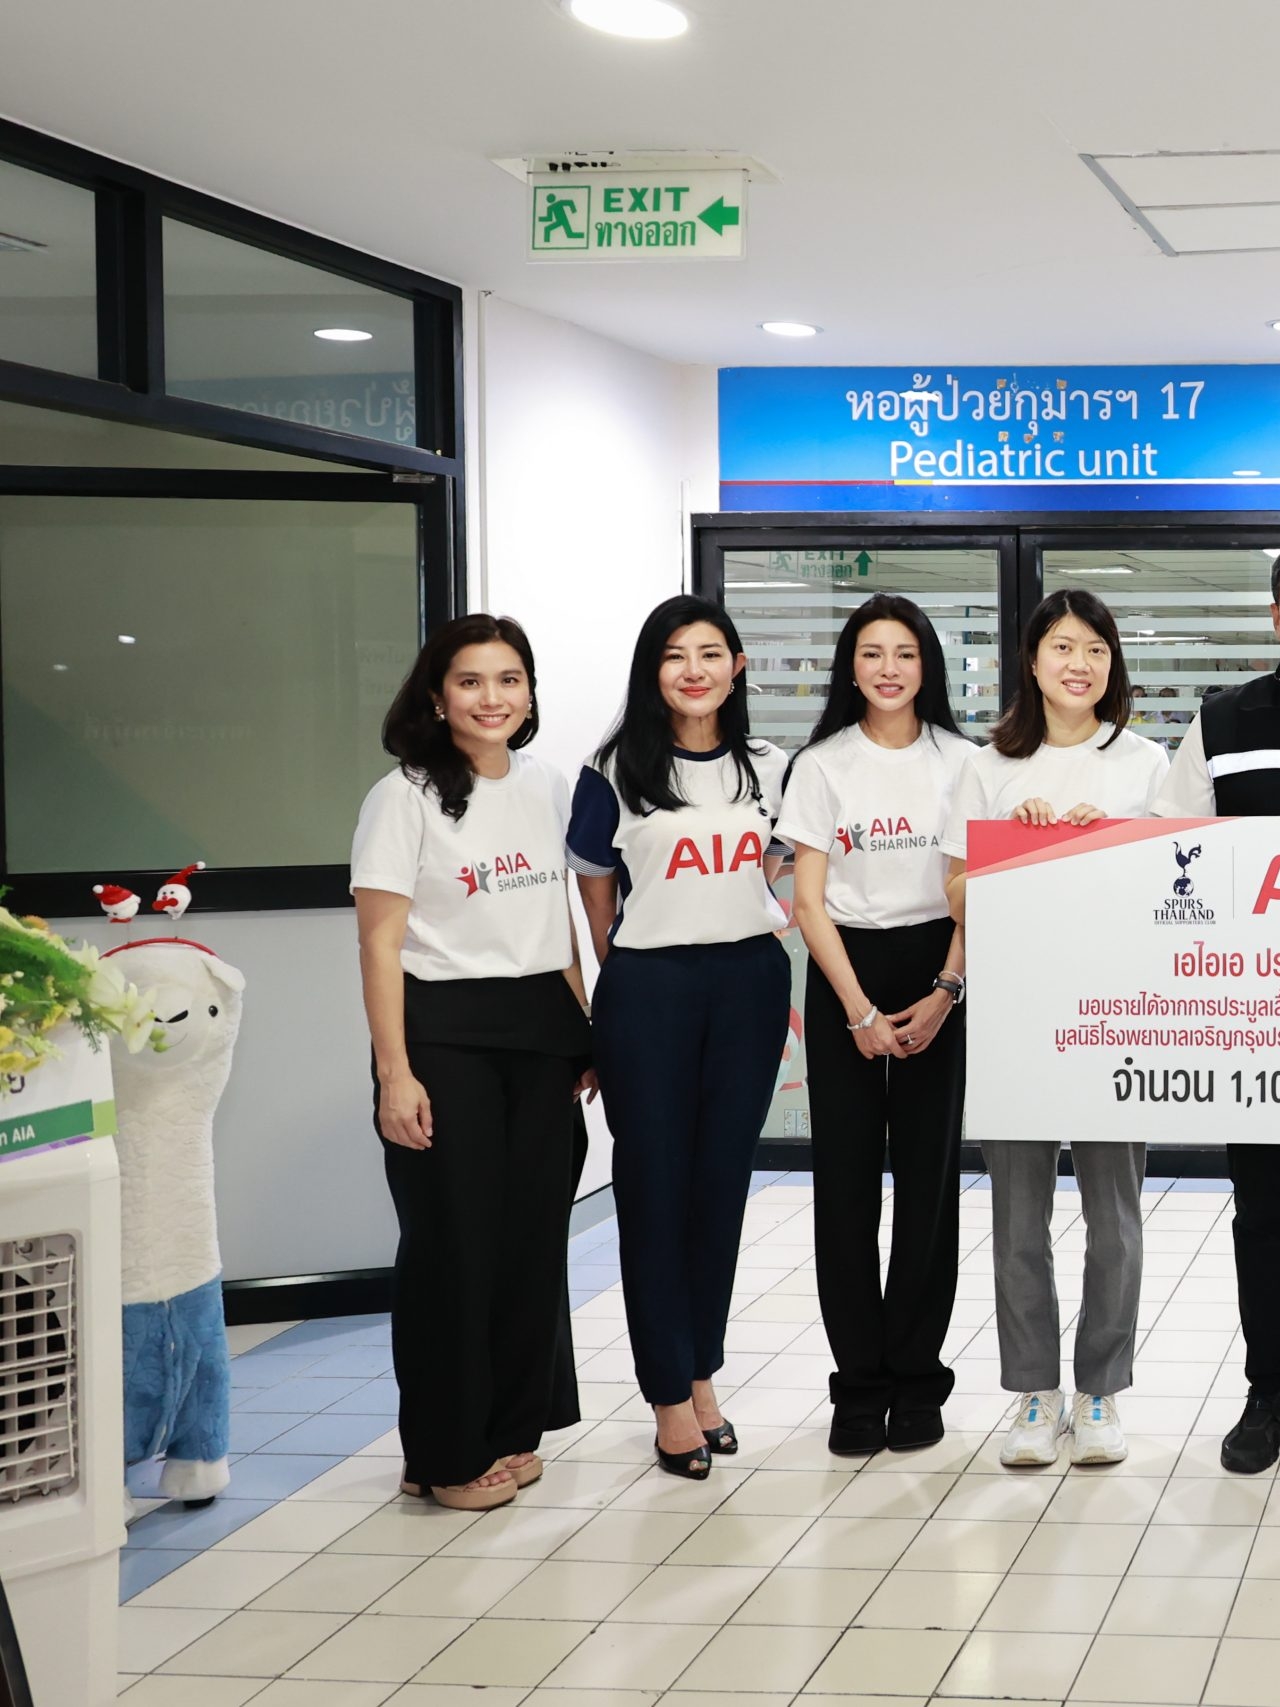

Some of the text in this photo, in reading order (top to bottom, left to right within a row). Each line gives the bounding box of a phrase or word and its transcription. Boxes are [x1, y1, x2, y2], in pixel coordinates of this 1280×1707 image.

[603, 187, 690, 212] EXIT
[595, 220, 697, 247] ทางออก
[845, 373, 1205, 436] หอผู้ป่วยกุมารฯ 17
[890, 439, 1158, 477] Pediatric unit
[870, 816, 913, 837] AIA
[665, 831, 762, 880] AIA
[870, 835, 939, 852] SHARING A
[495, 852, 532, 877] AIA
[497, 872, 548, 893] SHARING
[550, 870, 559, 882] A
[1153, 909, 1215, 921] THAILAND
[1164, 898, 1203, 910] SPURS
[1174, 940, 1244, 977] เอไอเอ
[1112, 1057, 1214, 1102] จำนวน
[12, 1124, 36, 1144] AIA
